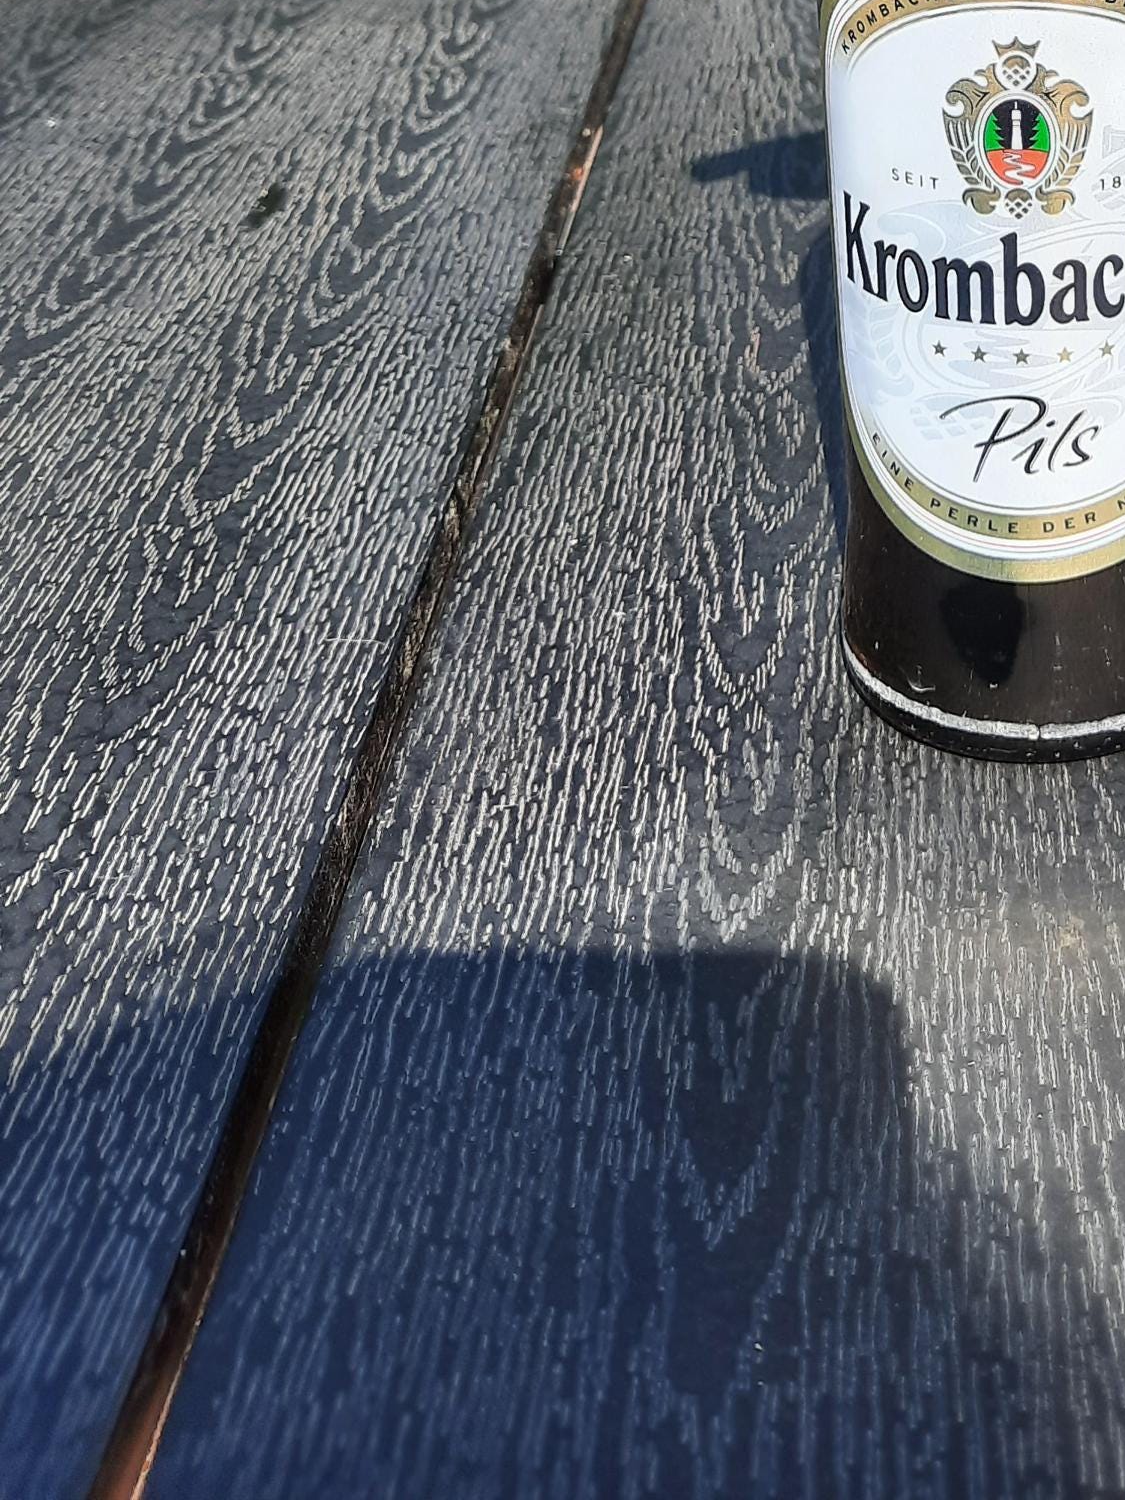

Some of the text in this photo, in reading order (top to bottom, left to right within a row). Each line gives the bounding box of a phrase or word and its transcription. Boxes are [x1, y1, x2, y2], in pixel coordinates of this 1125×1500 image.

[891, 167, 940, 191] SEIT
[871, 431, 915, 492] EINE
[929, 497, 1019, 534] PERLE
[1042, 511, 1097, 534] DER
[938, 395, 1103, 483] Pils
